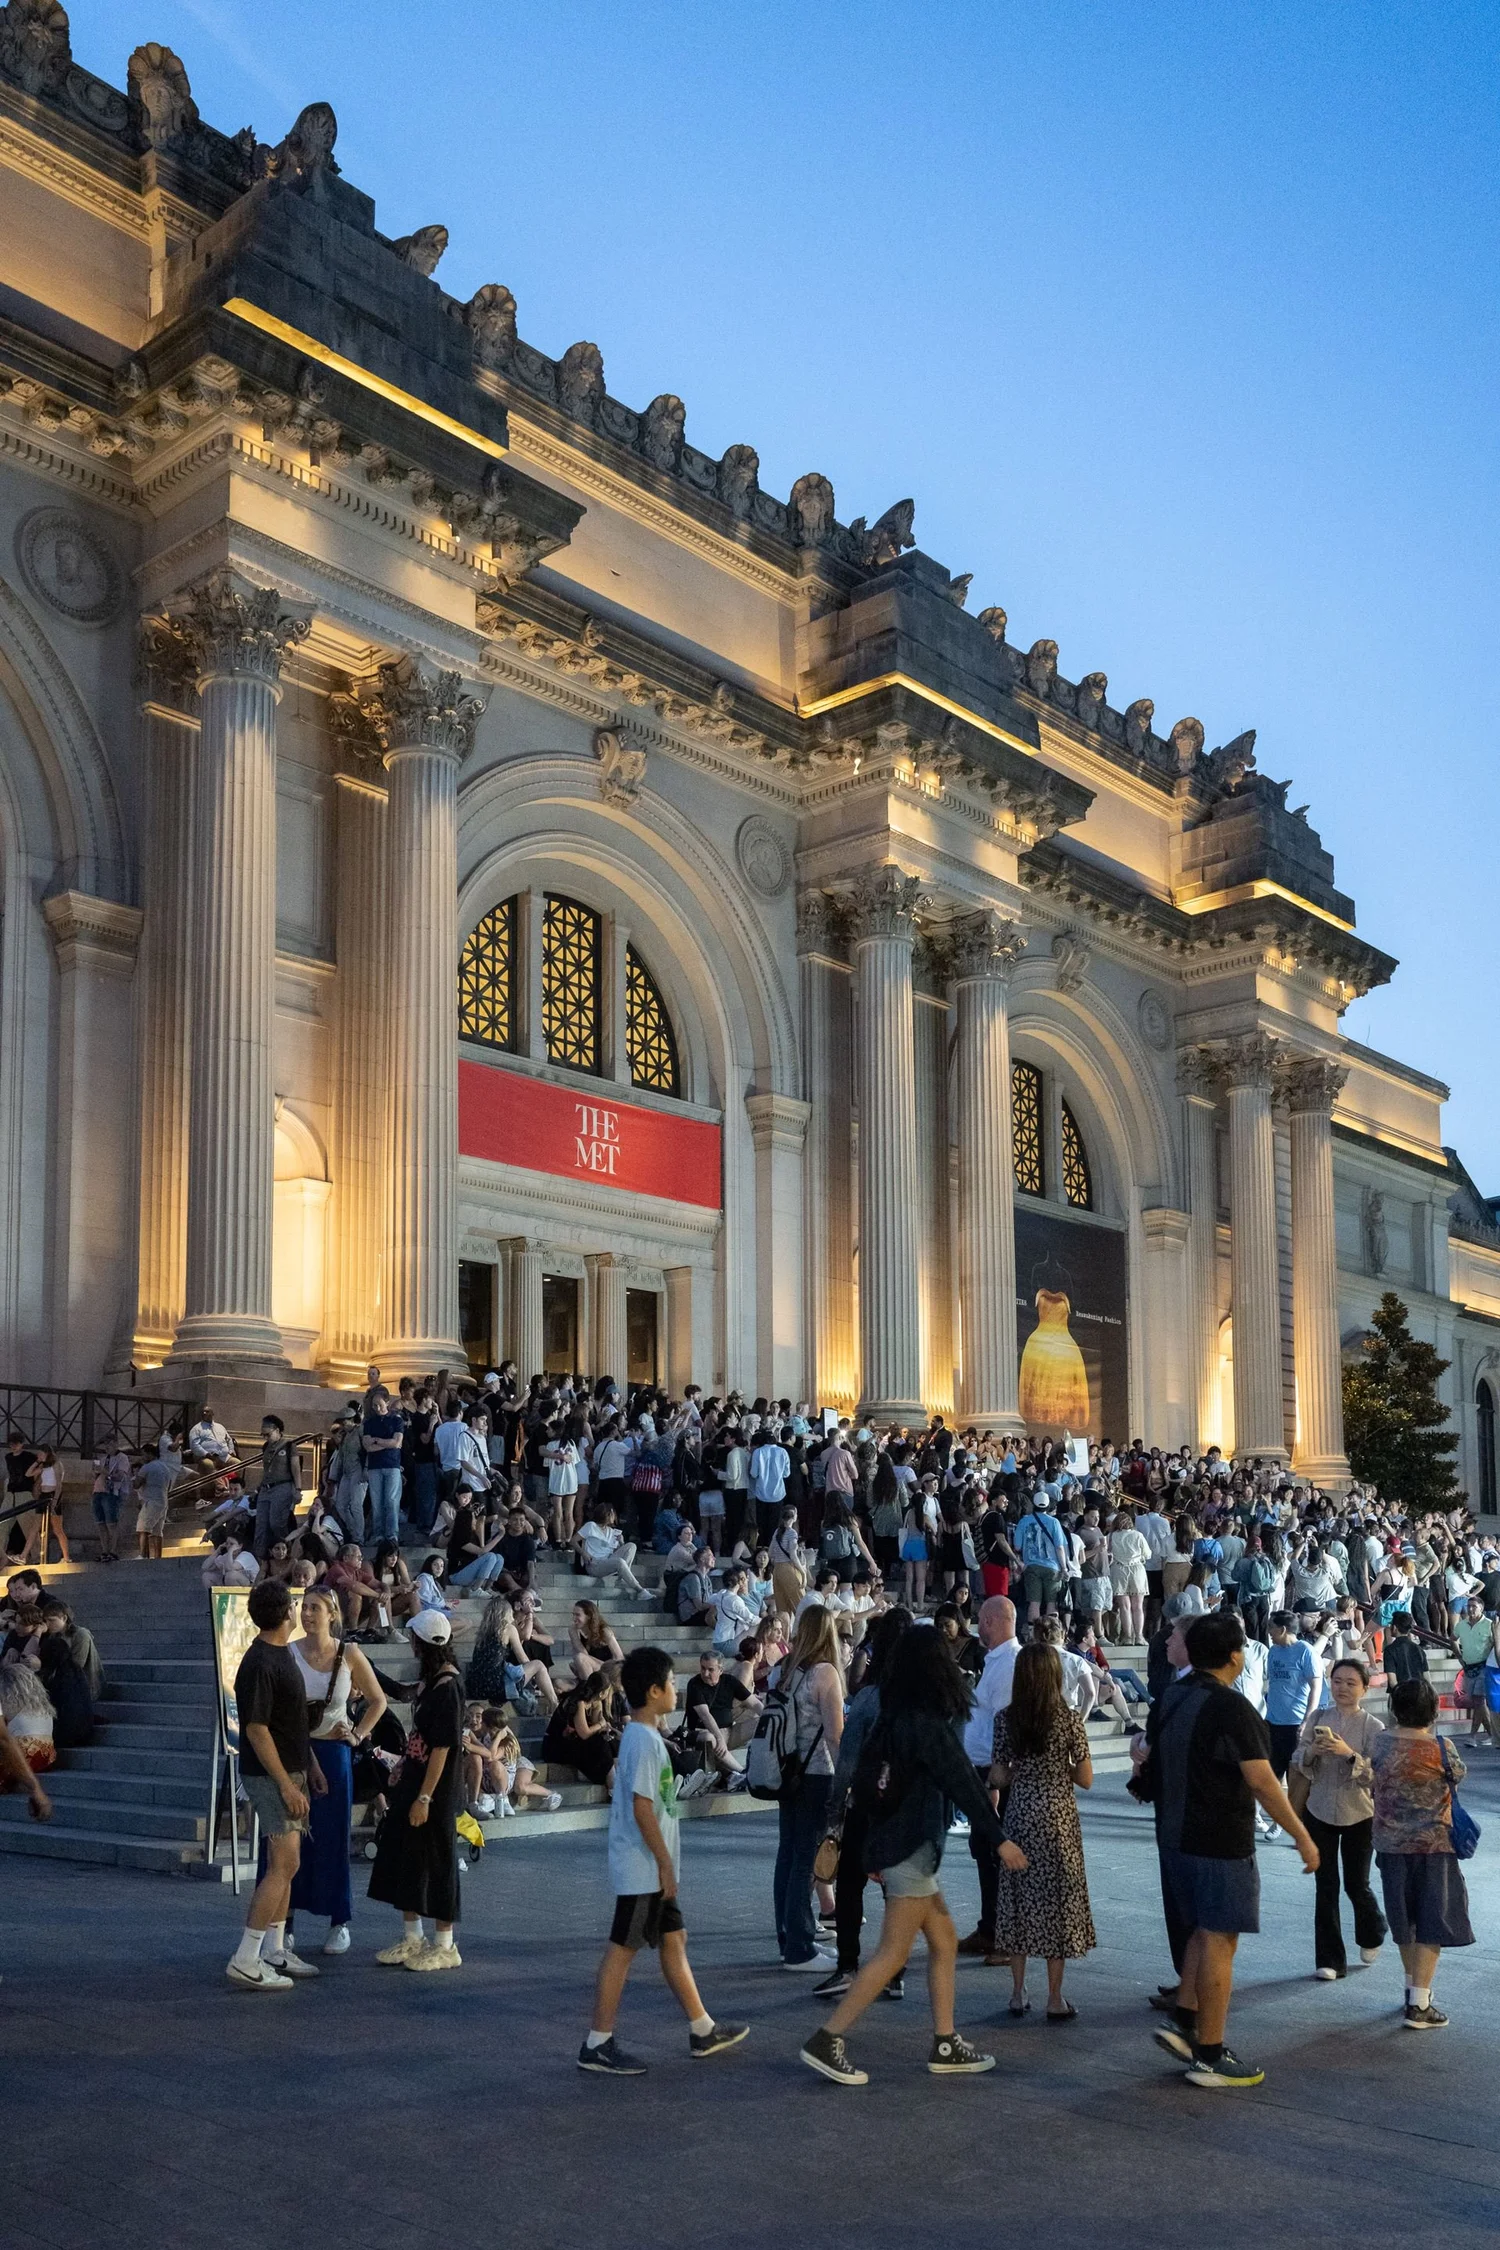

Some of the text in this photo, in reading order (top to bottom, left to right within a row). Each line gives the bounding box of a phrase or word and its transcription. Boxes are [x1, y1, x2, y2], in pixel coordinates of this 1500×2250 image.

[575, 1103, 620, 1142] THE
[574, 1136, 621, 1175] MET
[1075, 1310, 1122, 1325] Reawakening Fashion
